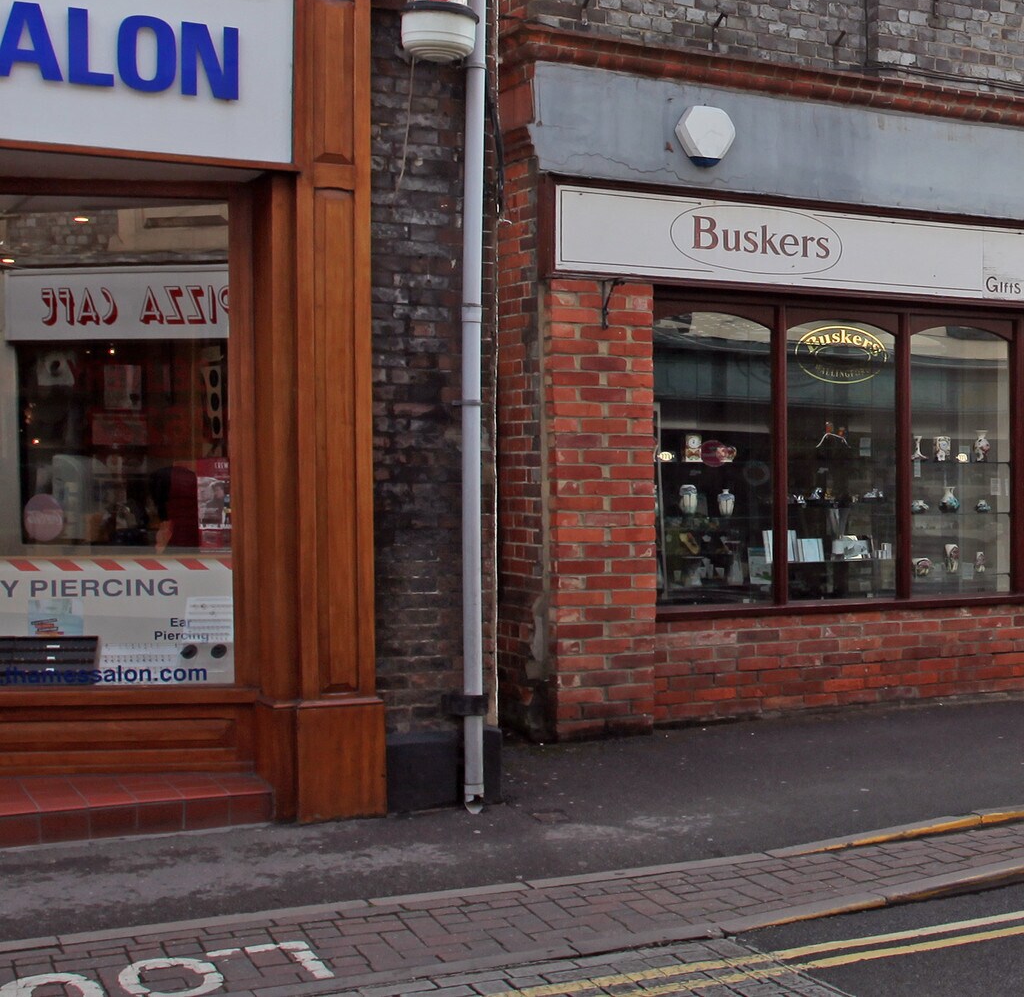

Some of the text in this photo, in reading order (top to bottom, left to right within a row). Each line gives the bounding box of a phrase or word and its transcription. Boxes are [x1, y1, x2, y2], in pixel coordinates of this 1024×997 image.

[0, 0, 239, 101] ALON
[691, 215, 831, 259] Buskers
[804, 329, 882, 357] Buskers
[30, 578, 179, 598] PIERCING
[170, 617, 192, 628] Ear
[154, 631, 210, 643] Piercing
